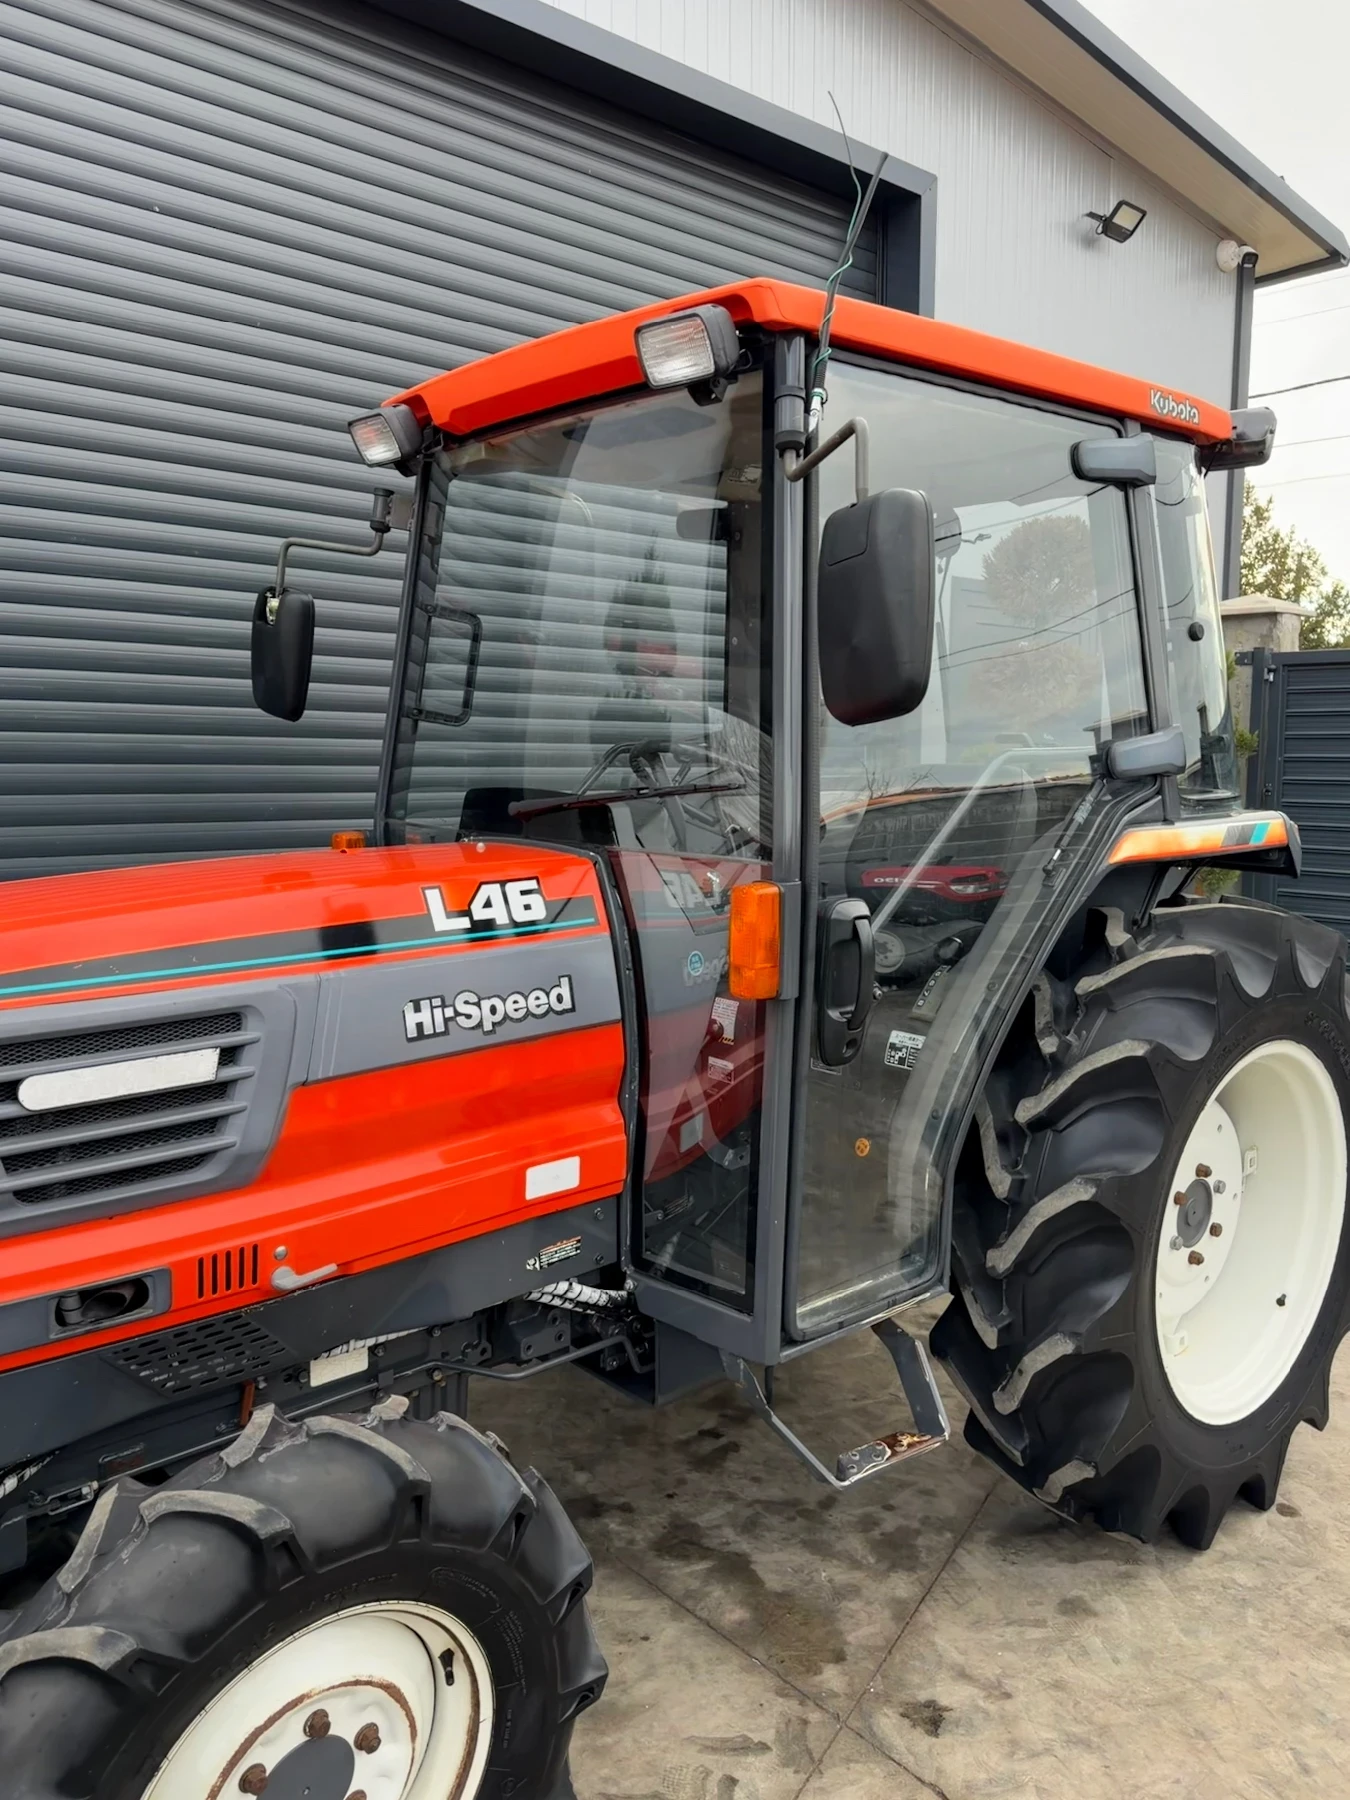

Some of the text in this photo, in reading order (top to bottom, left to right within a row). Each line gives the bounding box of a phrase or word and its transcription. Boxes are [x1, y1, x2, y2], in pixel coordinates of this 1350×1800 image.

[1150, 389, 1199, 424] Kubota
[423, 878, 547, 932] L46
[403, 976, 574, 1039] Hi-Speed
